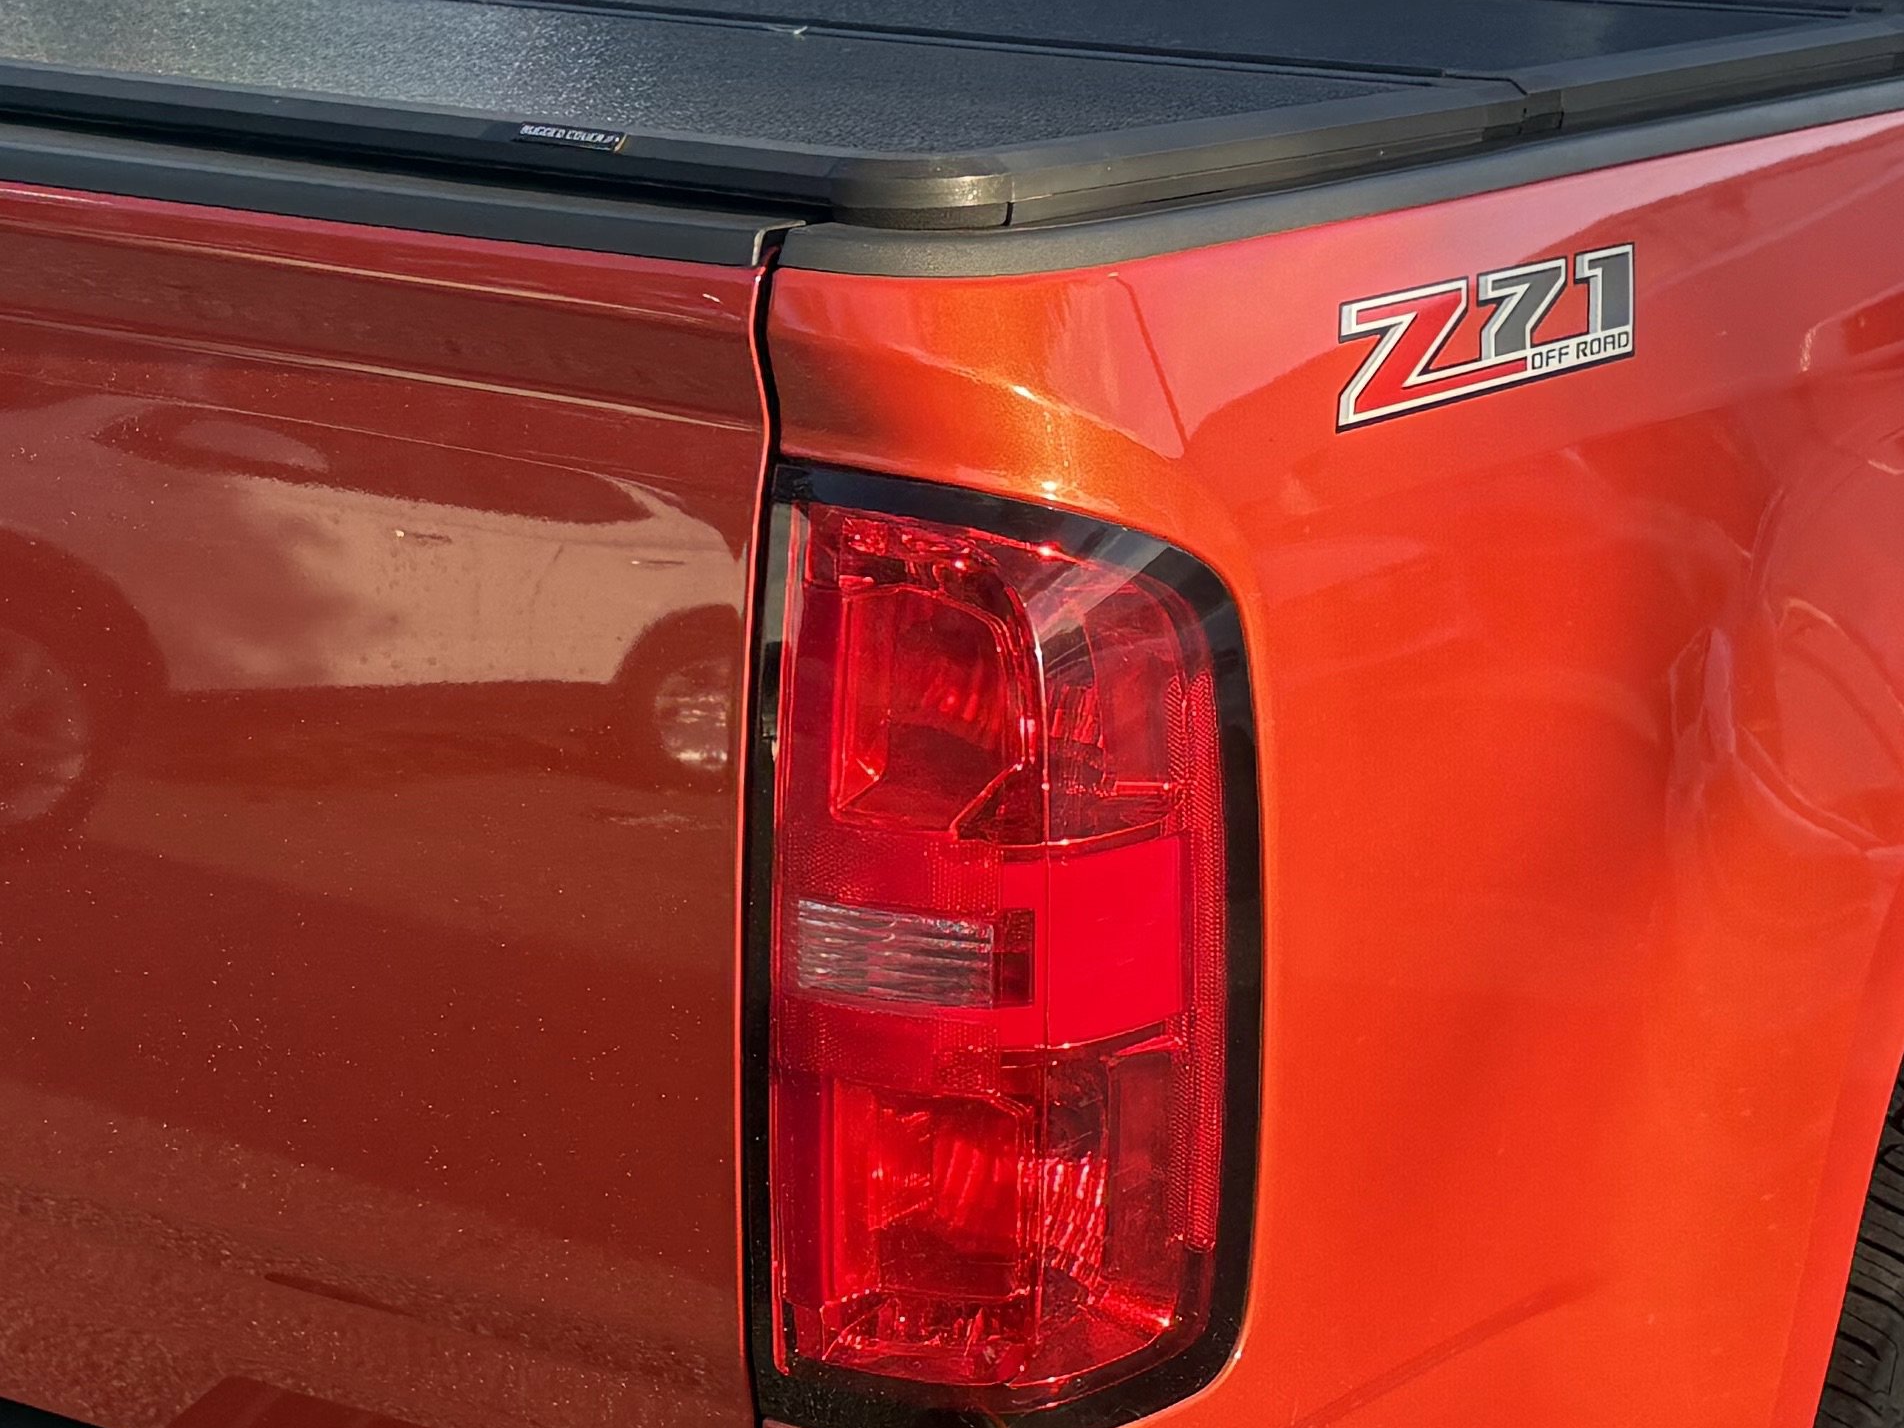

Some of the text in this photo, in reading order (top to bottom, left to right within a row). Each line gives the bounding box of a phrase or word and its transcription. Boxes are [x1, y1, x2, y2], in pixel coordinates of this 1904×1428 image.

[1336, 242, 1635, 433] Z71
[1531, 331, 1630, 370] OFF ROAD
